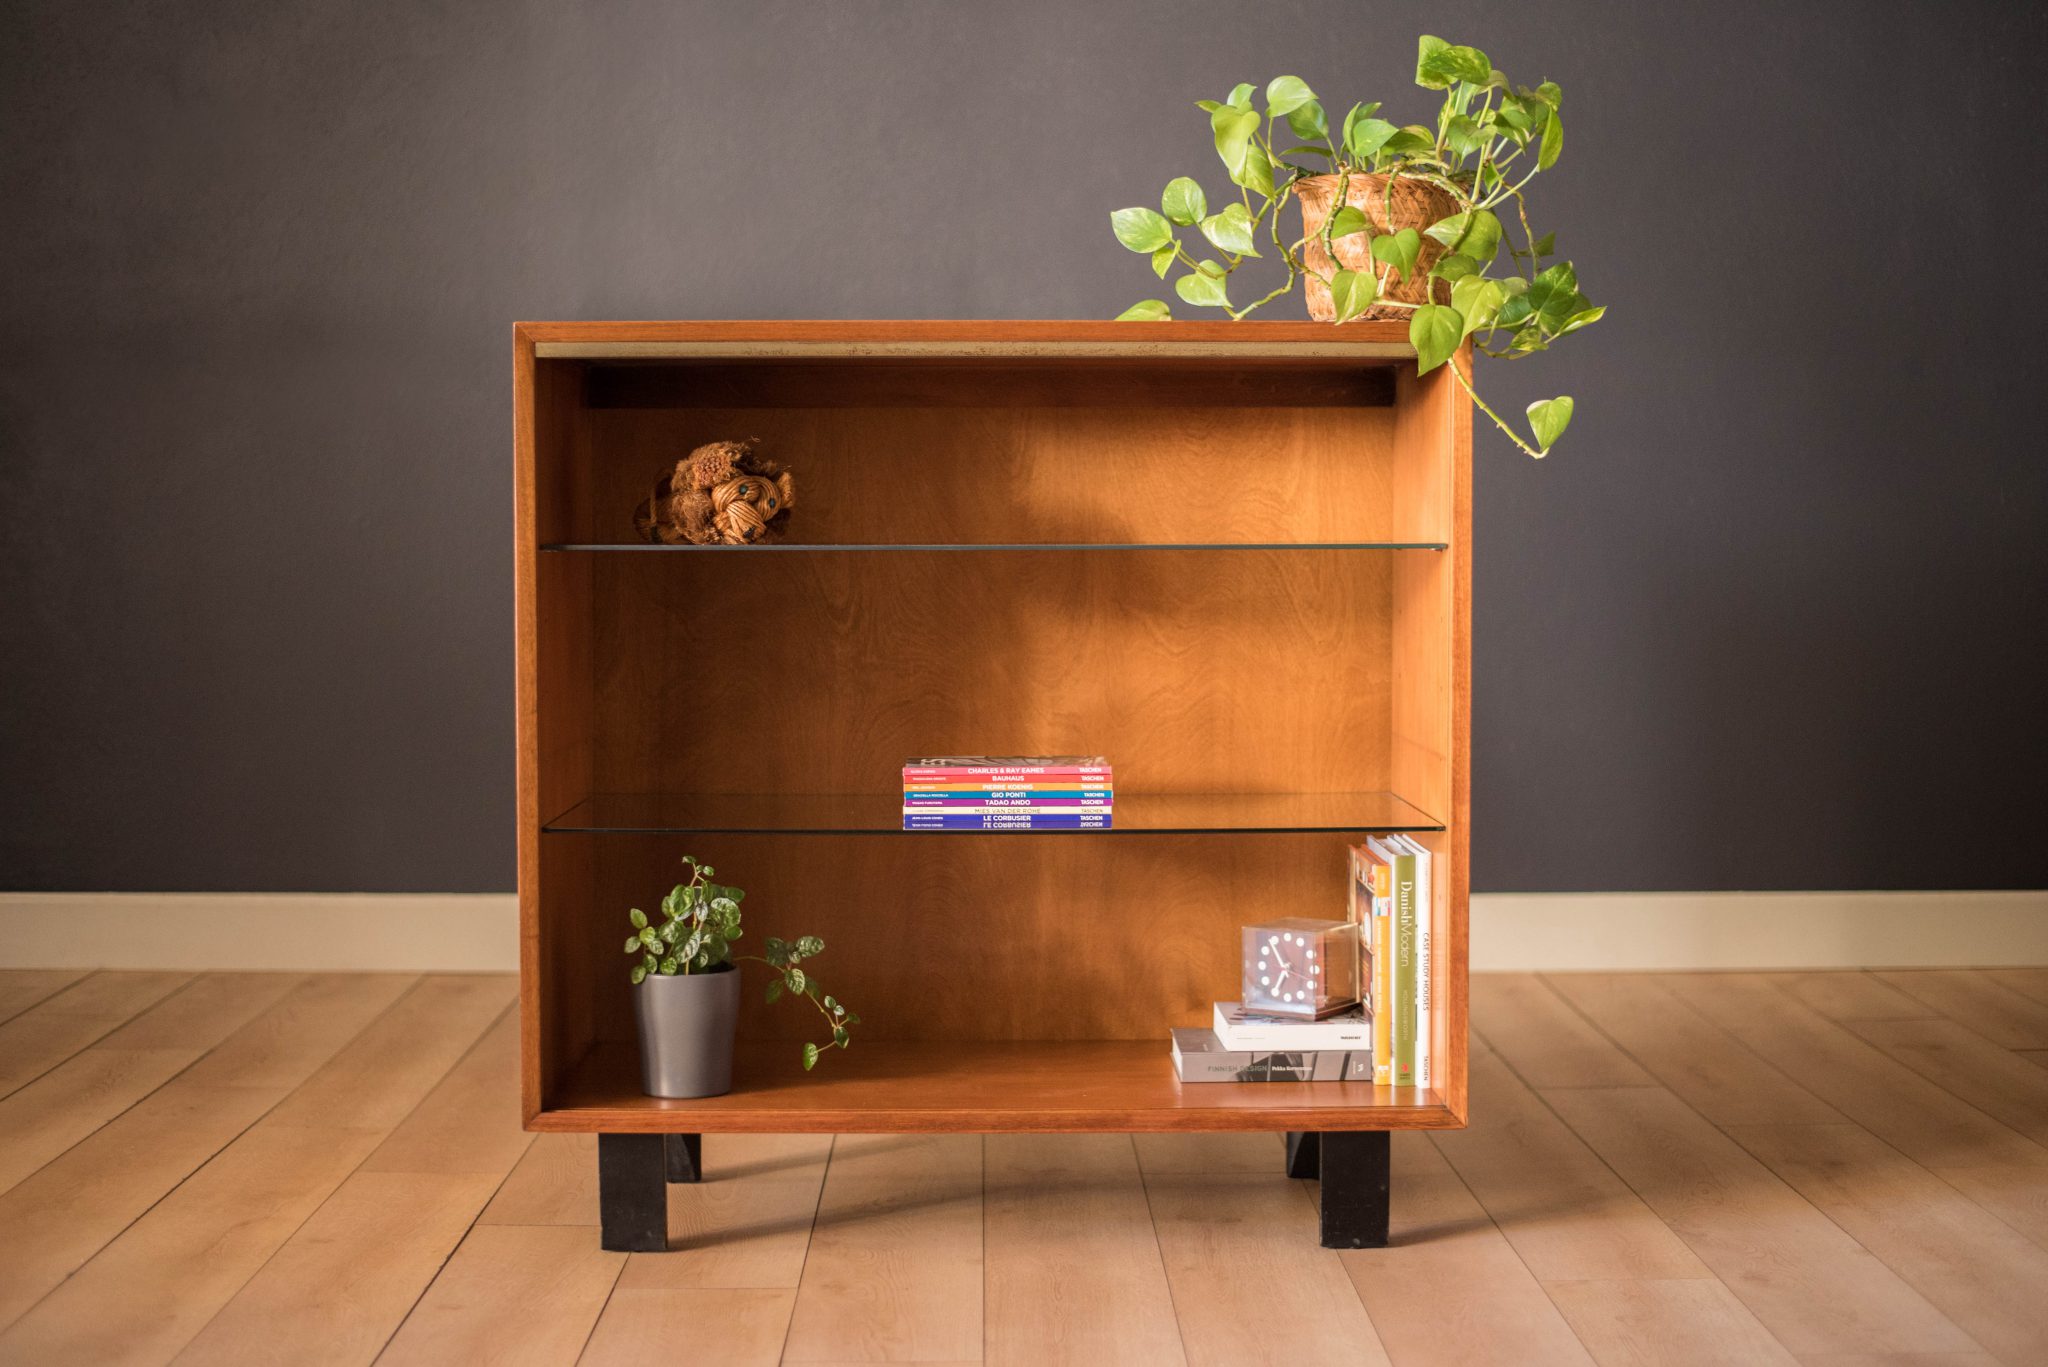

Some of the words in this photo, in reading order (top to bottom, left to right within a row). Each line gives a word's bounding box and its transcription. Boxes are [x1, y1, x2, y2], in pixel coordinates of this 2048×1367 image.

[1422, 932, 1430, 951] CASE
[1422, 953, 1430, 978] STUDY
[1422, 980, 1430, 1011] HOUSES
